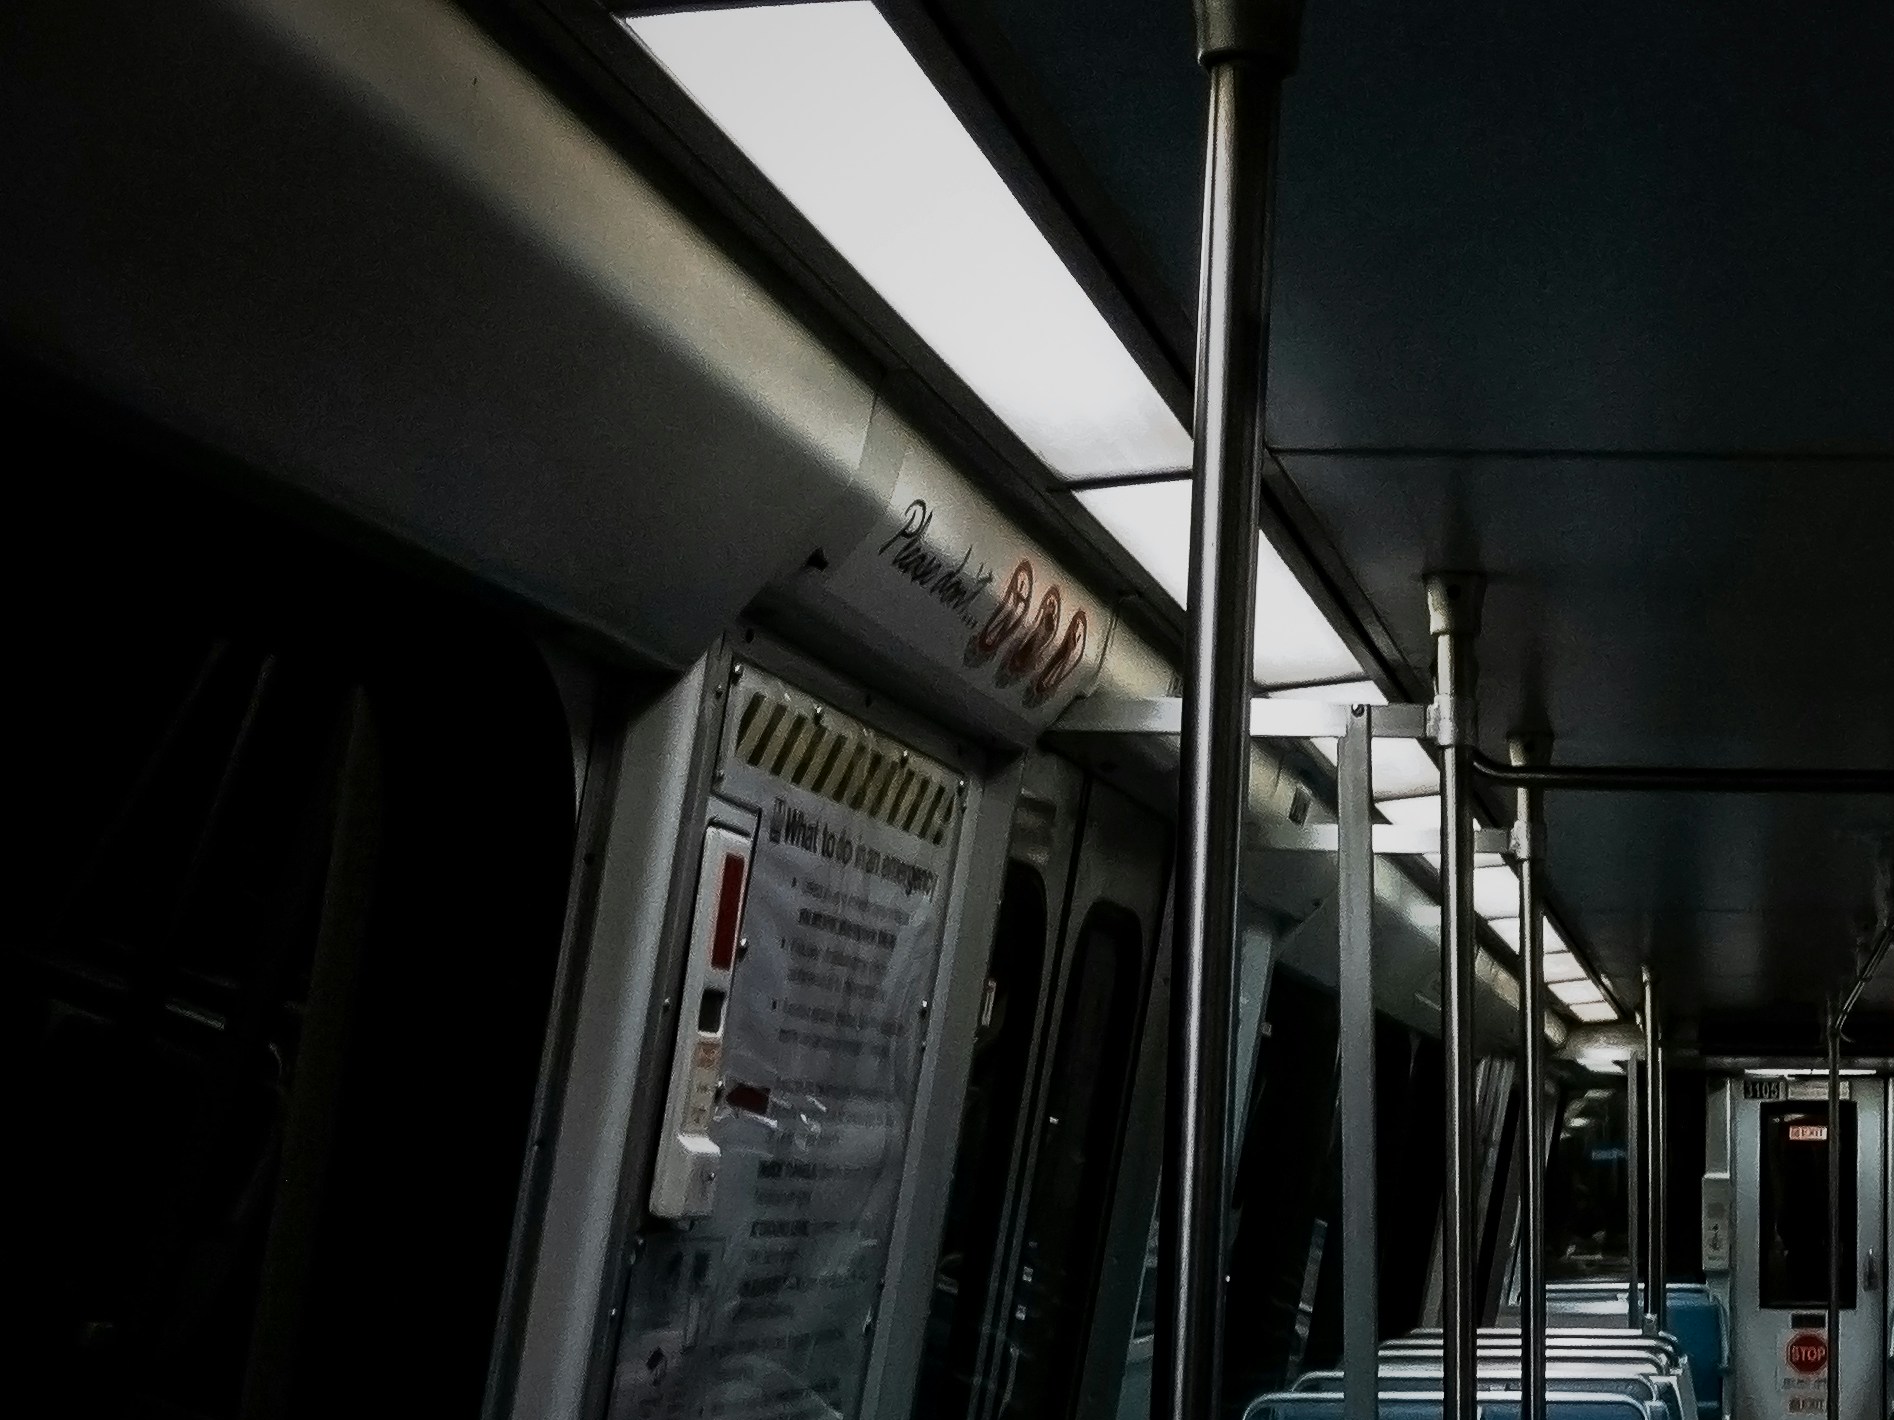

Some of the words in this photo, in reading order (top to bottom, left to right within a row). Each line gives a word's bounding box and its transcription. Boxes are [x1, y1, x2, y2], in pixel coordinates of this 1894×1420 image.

[785, 807, 819, 853] What
[822, 823, 835, 858] to
[1791, 1345, 1826, 1361] STOP
